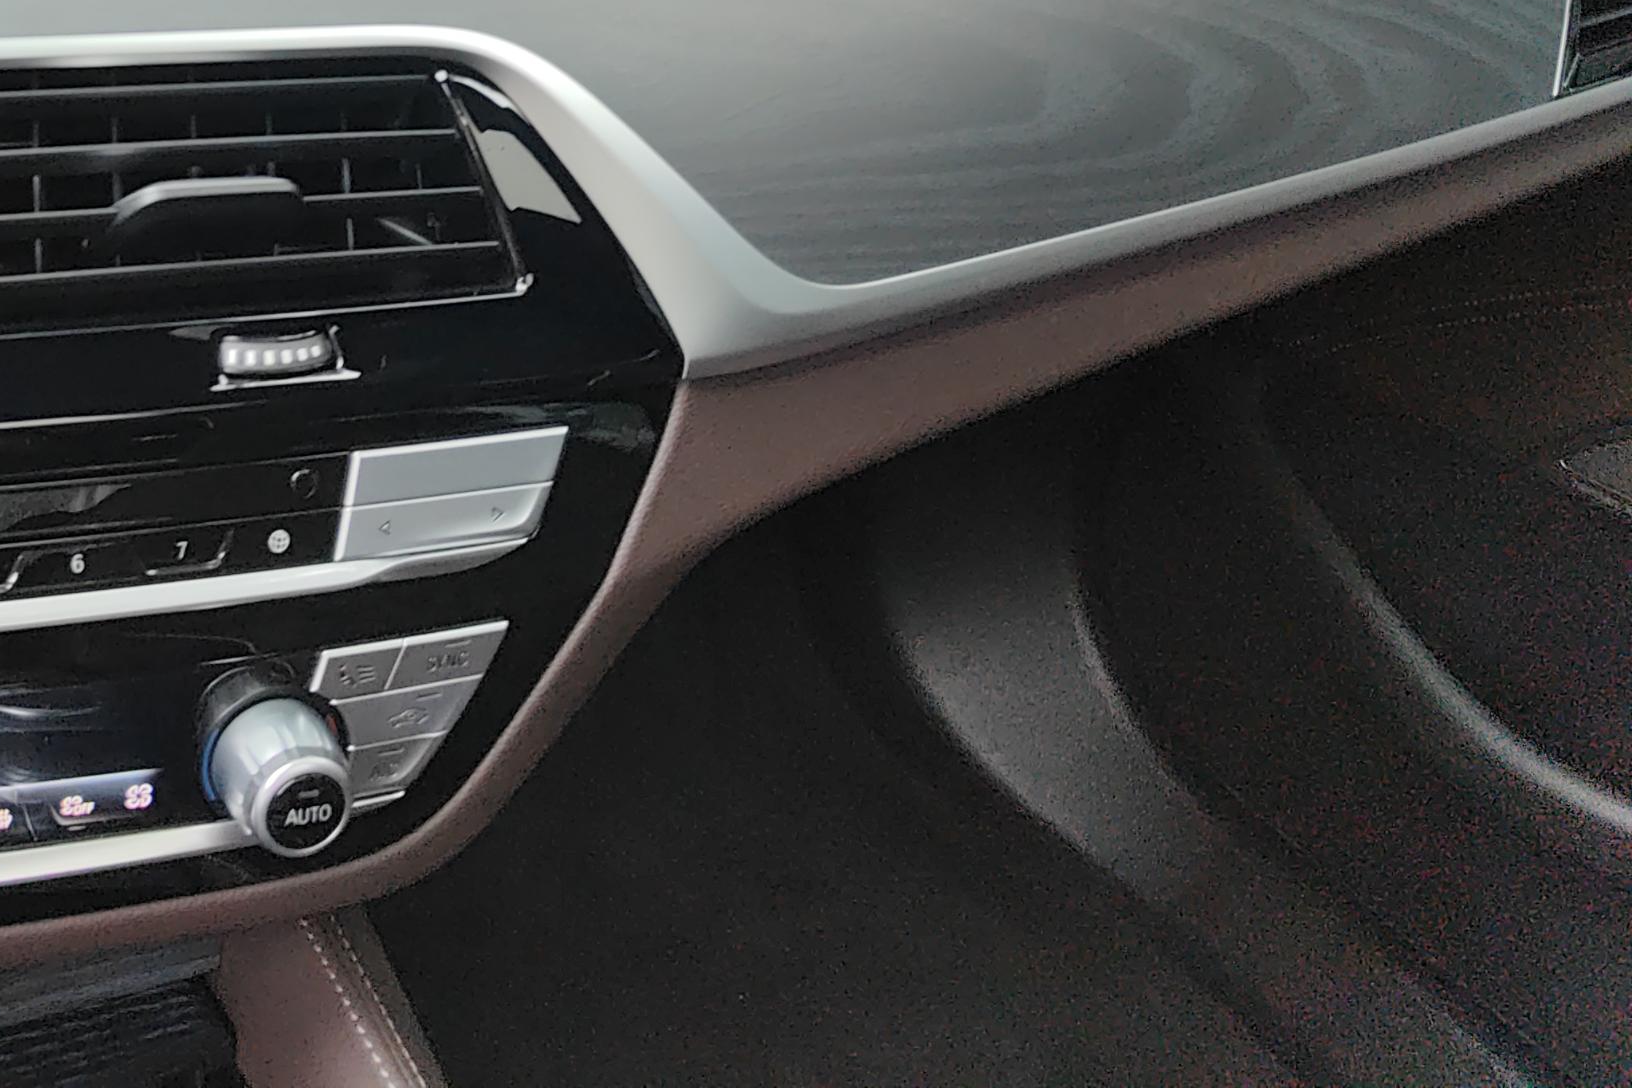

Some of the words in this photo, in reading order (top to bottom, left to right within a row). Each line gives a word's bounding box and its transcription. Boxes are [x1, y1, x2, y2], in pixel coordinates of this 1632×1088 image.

[175, 540, 188, 561] 7
[69, 553, 85, 574] 6
[283, 803, 333, 828] AUTO
